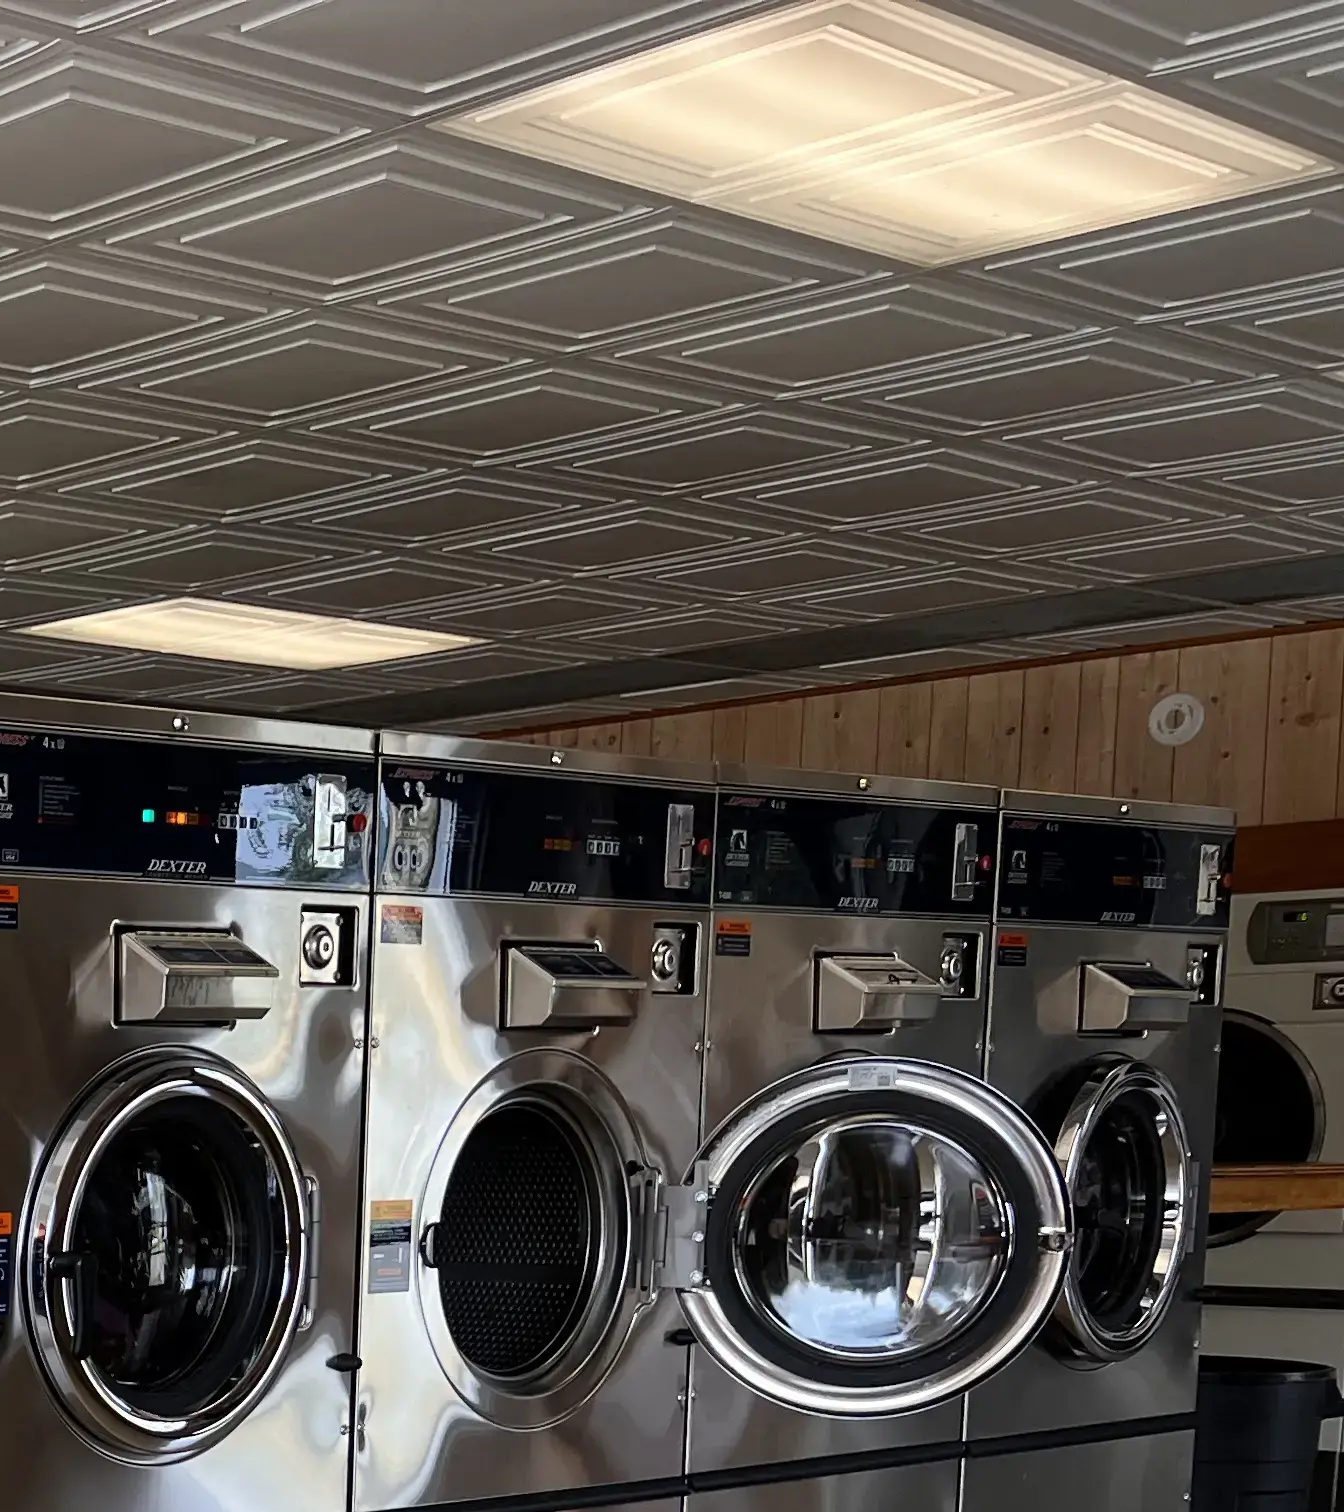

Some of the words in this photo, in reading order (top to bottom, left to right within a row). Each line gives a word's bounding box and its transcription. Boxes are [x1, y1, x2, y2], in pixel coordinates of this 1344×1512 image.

[147, 859, 207, 873] DEXTER
[528, 881, 577, 894] DEXTER
[838, 897, 879, 908] DEXTER
[1100, 911, 1136, 922] DEXTER
